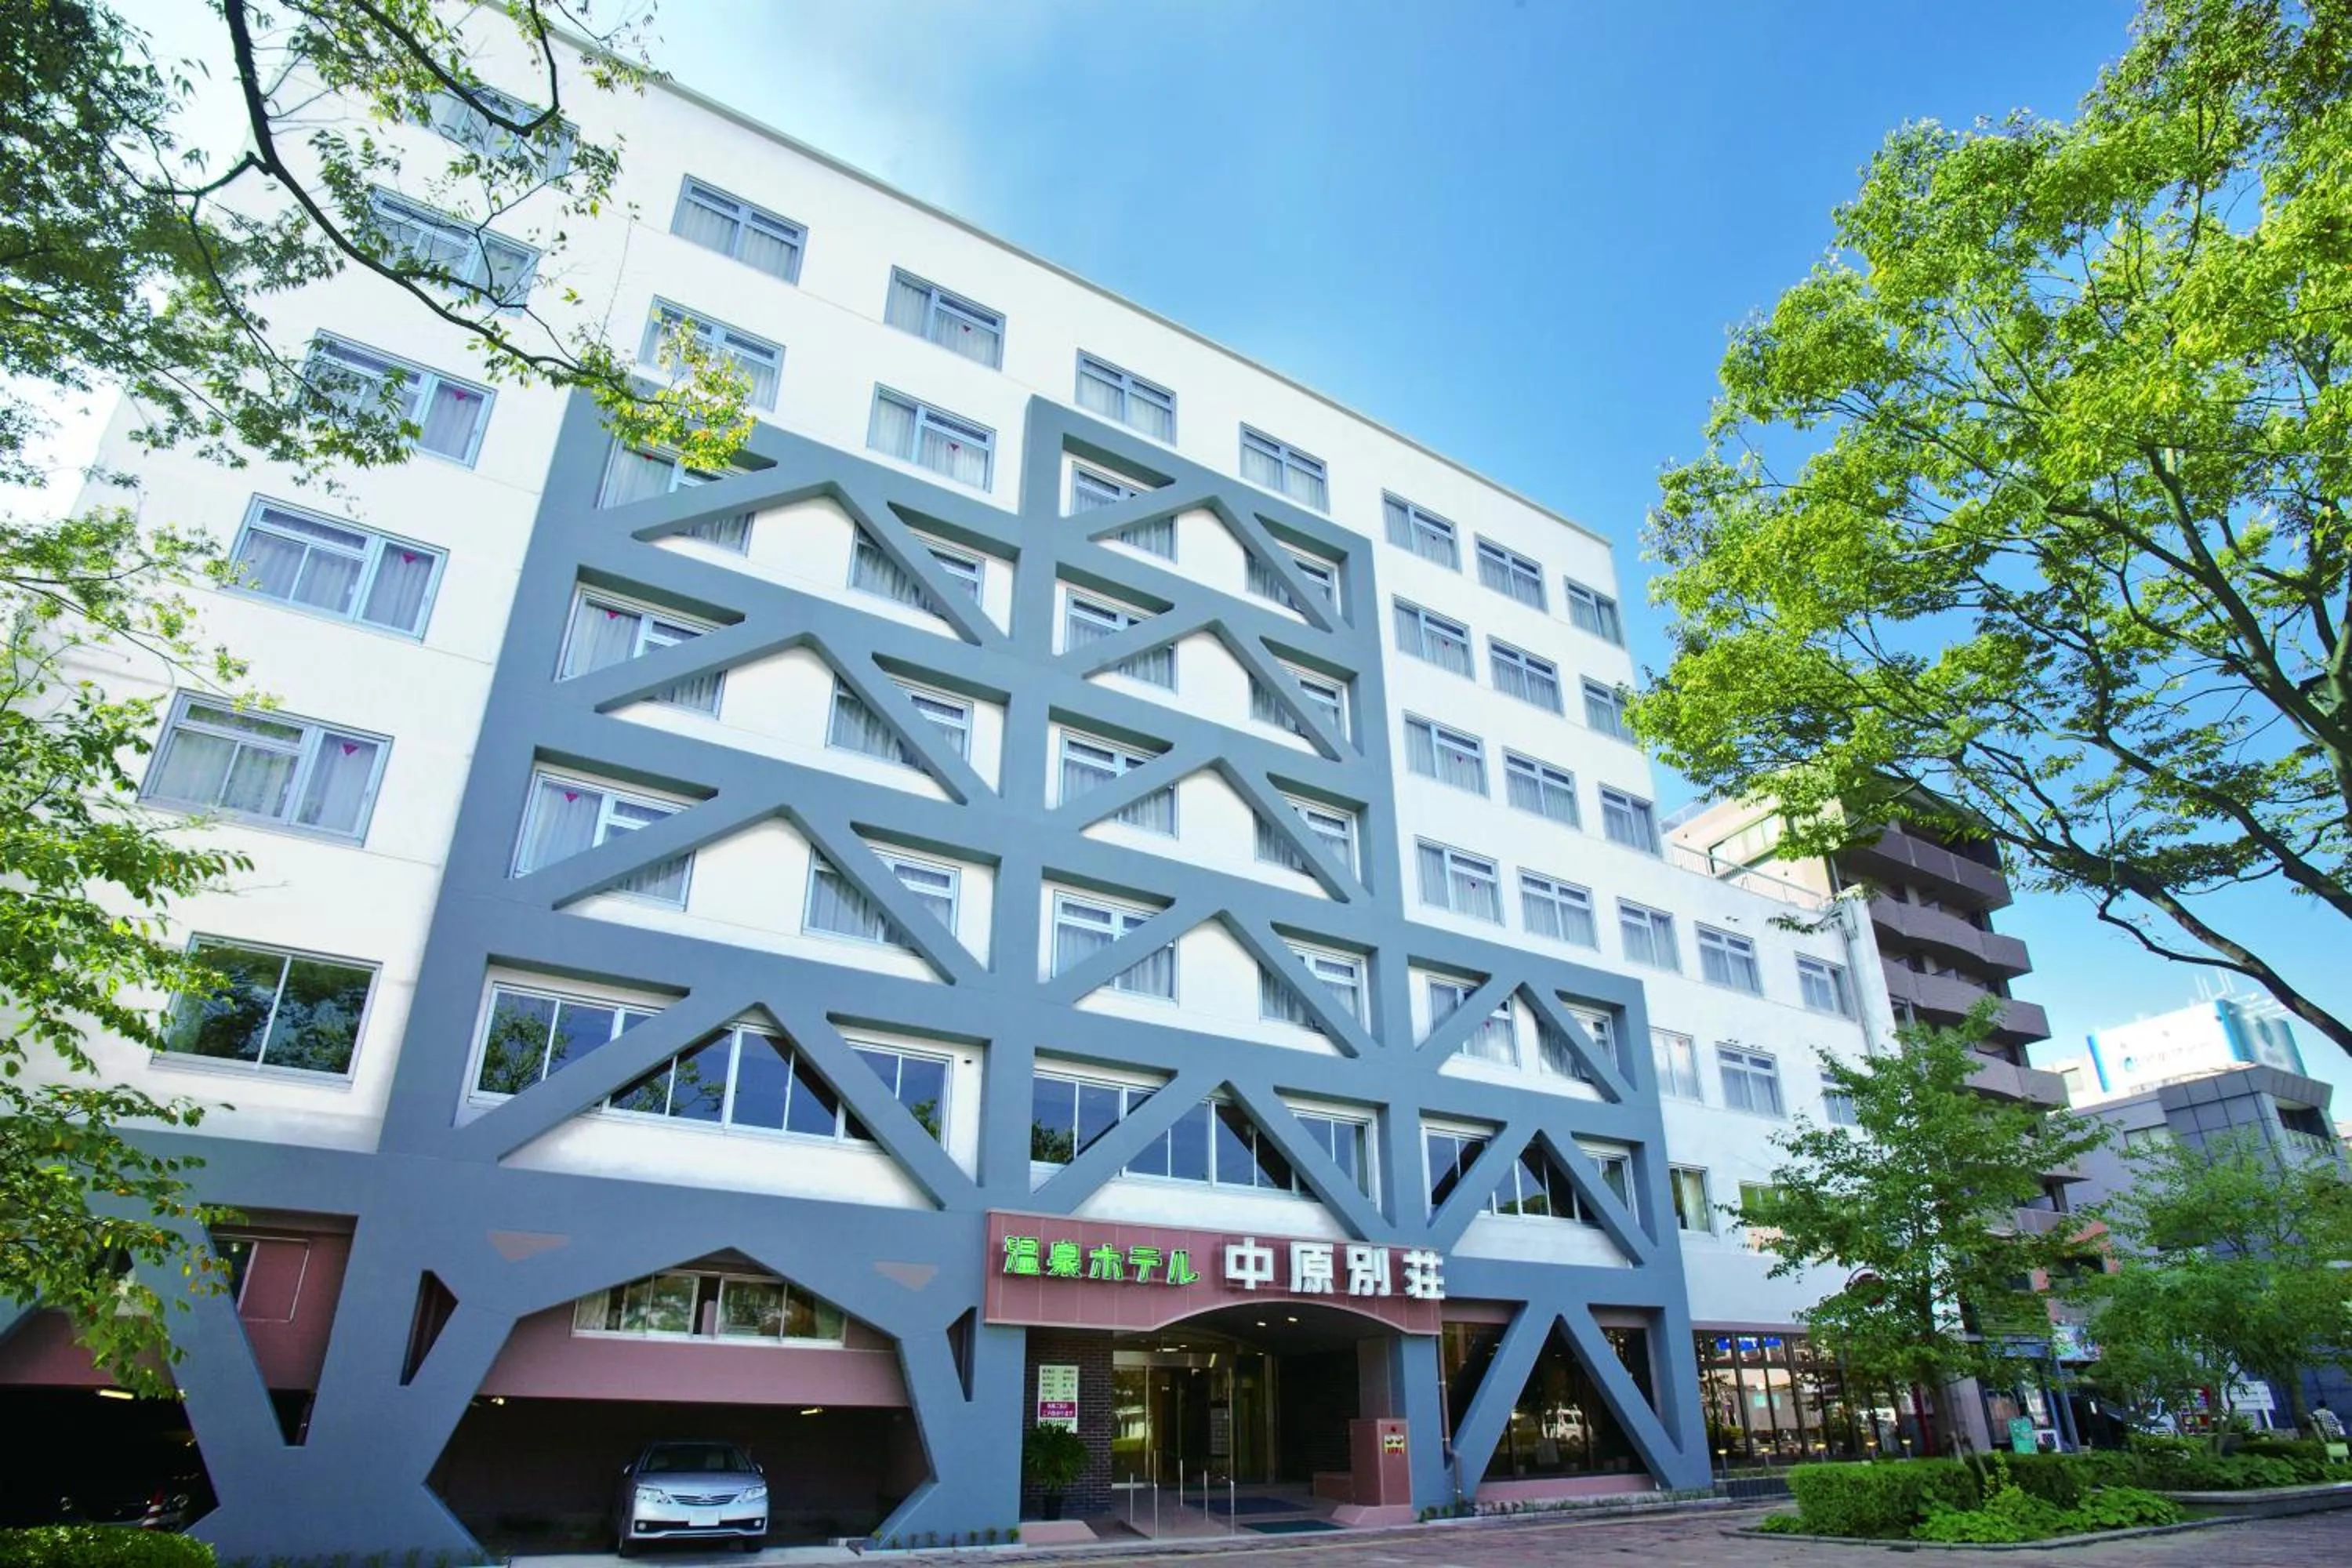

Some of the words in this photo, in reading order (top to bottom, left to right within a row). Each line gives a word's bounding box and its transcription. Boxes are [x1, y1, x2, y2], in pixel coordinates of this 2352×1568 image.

[1004, 1236, 1200, 1284] 温泉ホテル
[1225, 1237, 1445, 1299] 中原別荘
